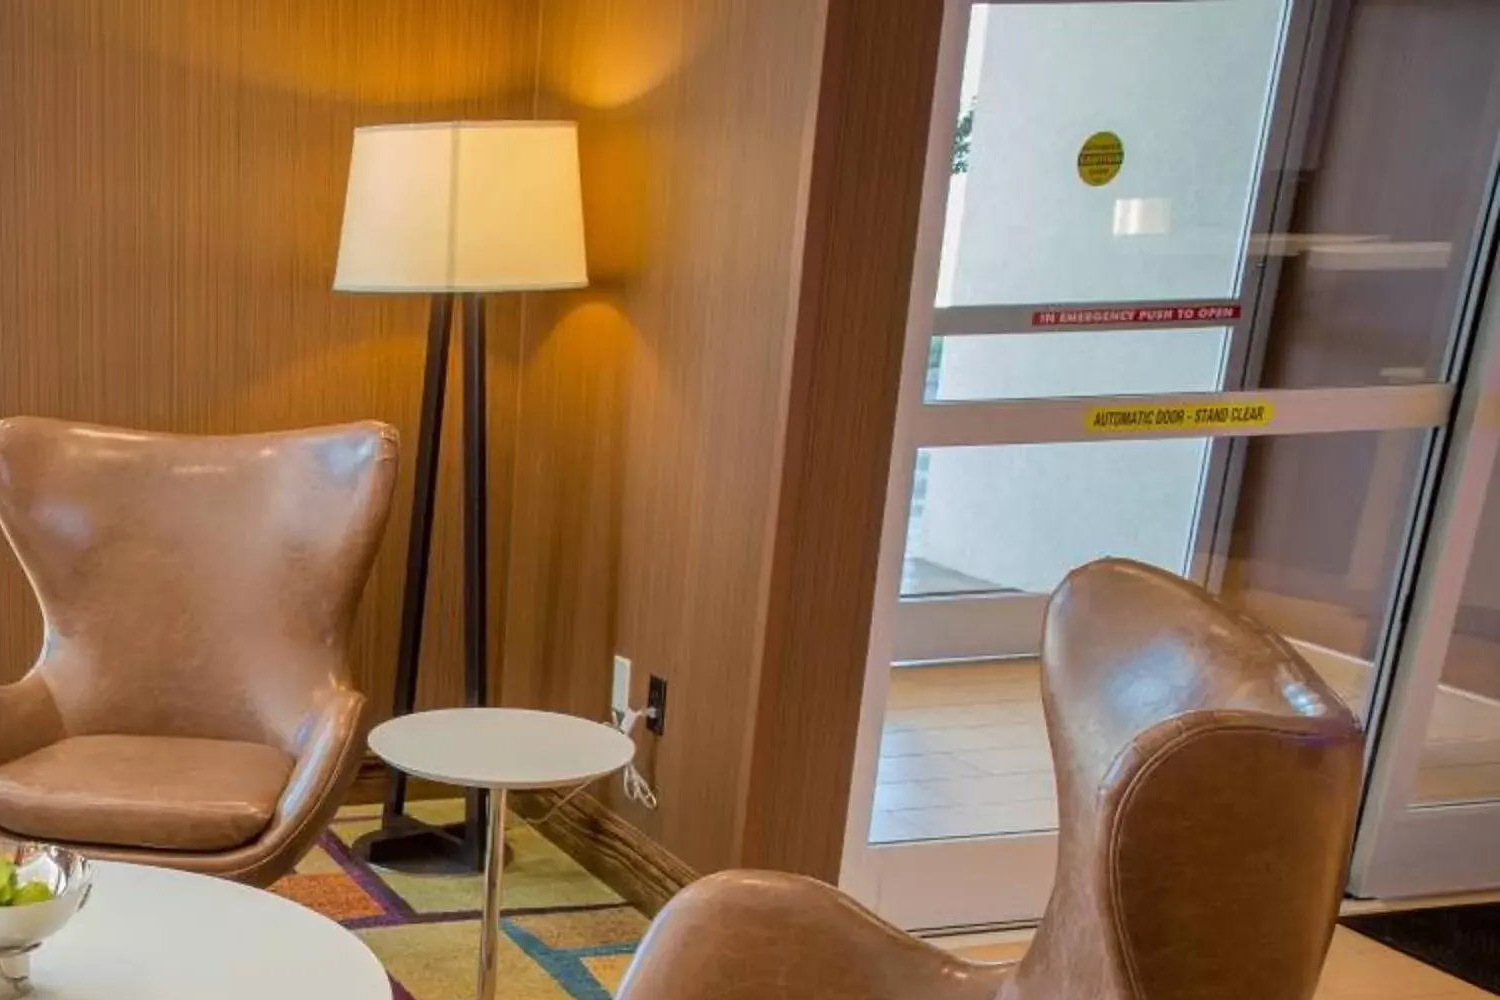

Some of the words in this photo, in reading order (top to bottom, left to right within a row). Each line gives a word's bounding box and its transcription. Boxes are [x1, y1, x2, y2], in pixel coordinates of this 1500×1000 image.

[1039, 314, 1055, 324] IN
[1059, 311, 1135, 323] EMERGENCY
[1139, 309, 1174, 321] PUSH
[1177, 308, 1194, 320] TO
[1198, 307, 1233, 319] OPEN
[1093, 410, 1153, 427] AUTOMATIC
[1156, 408, 1184, 424] DOOR
[1194, 407, 1228, 423] STAND
[1231, 405, 1264, 421] CLEAR
